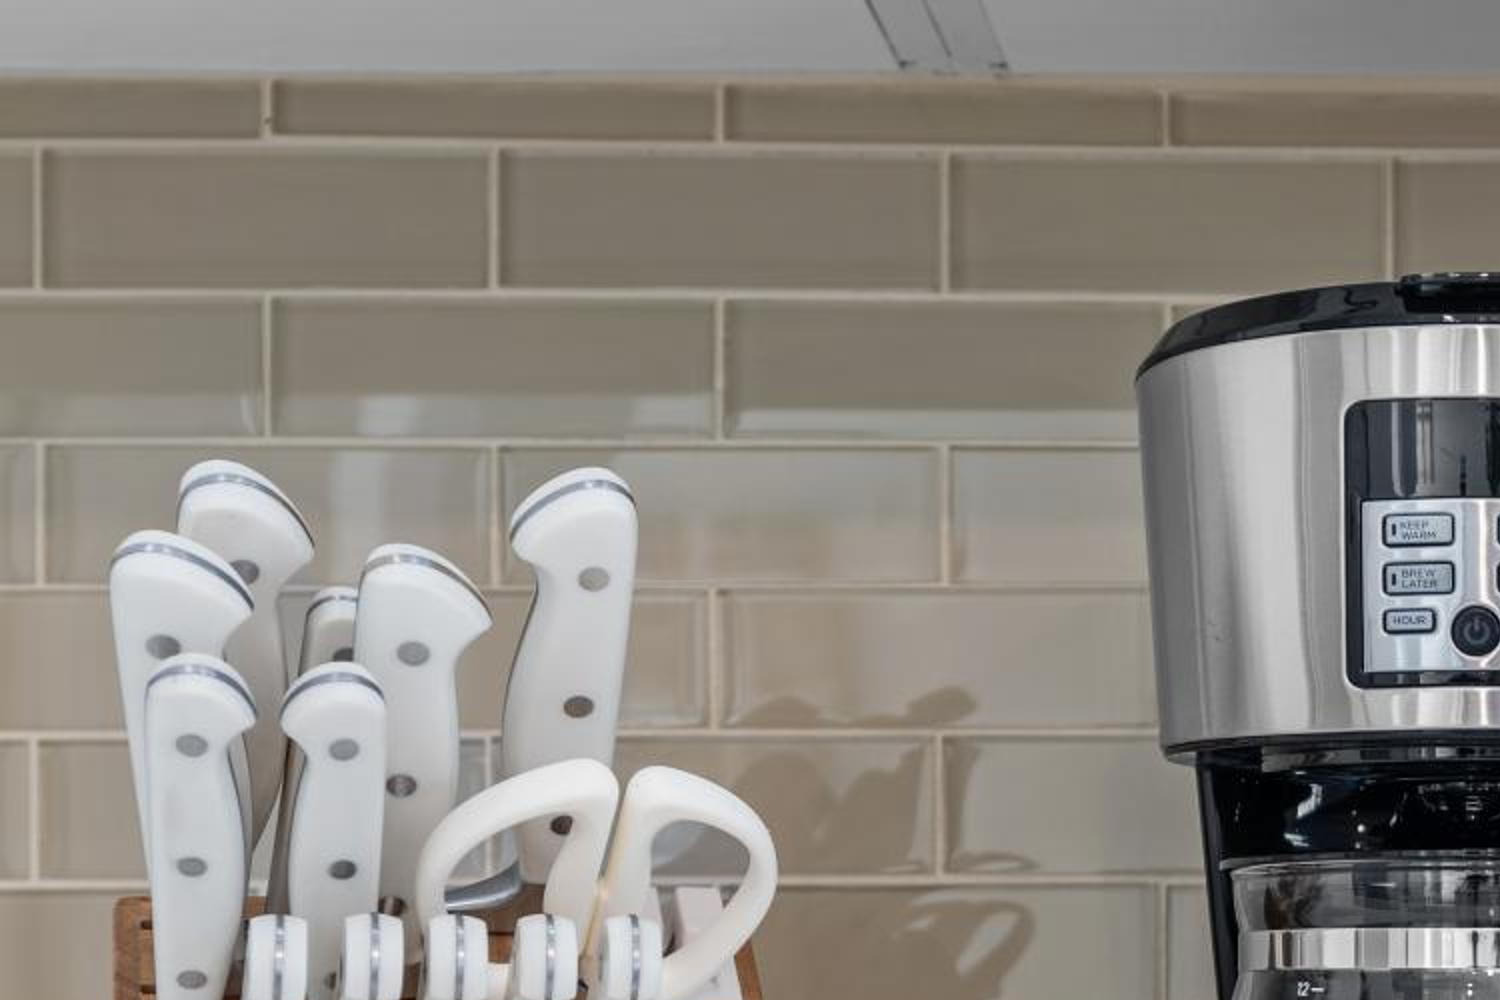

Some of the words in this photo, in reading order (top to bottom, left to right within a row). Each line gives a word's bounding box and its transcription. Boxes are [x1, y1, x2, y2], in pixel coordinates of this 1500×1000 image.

[1402, 567, 1436, 578] BREW
[1402, 579, 1438, 589] LATER
[1393, 615, 1427, 626] HOUR
[1297, 981, 1311, 997] 12
